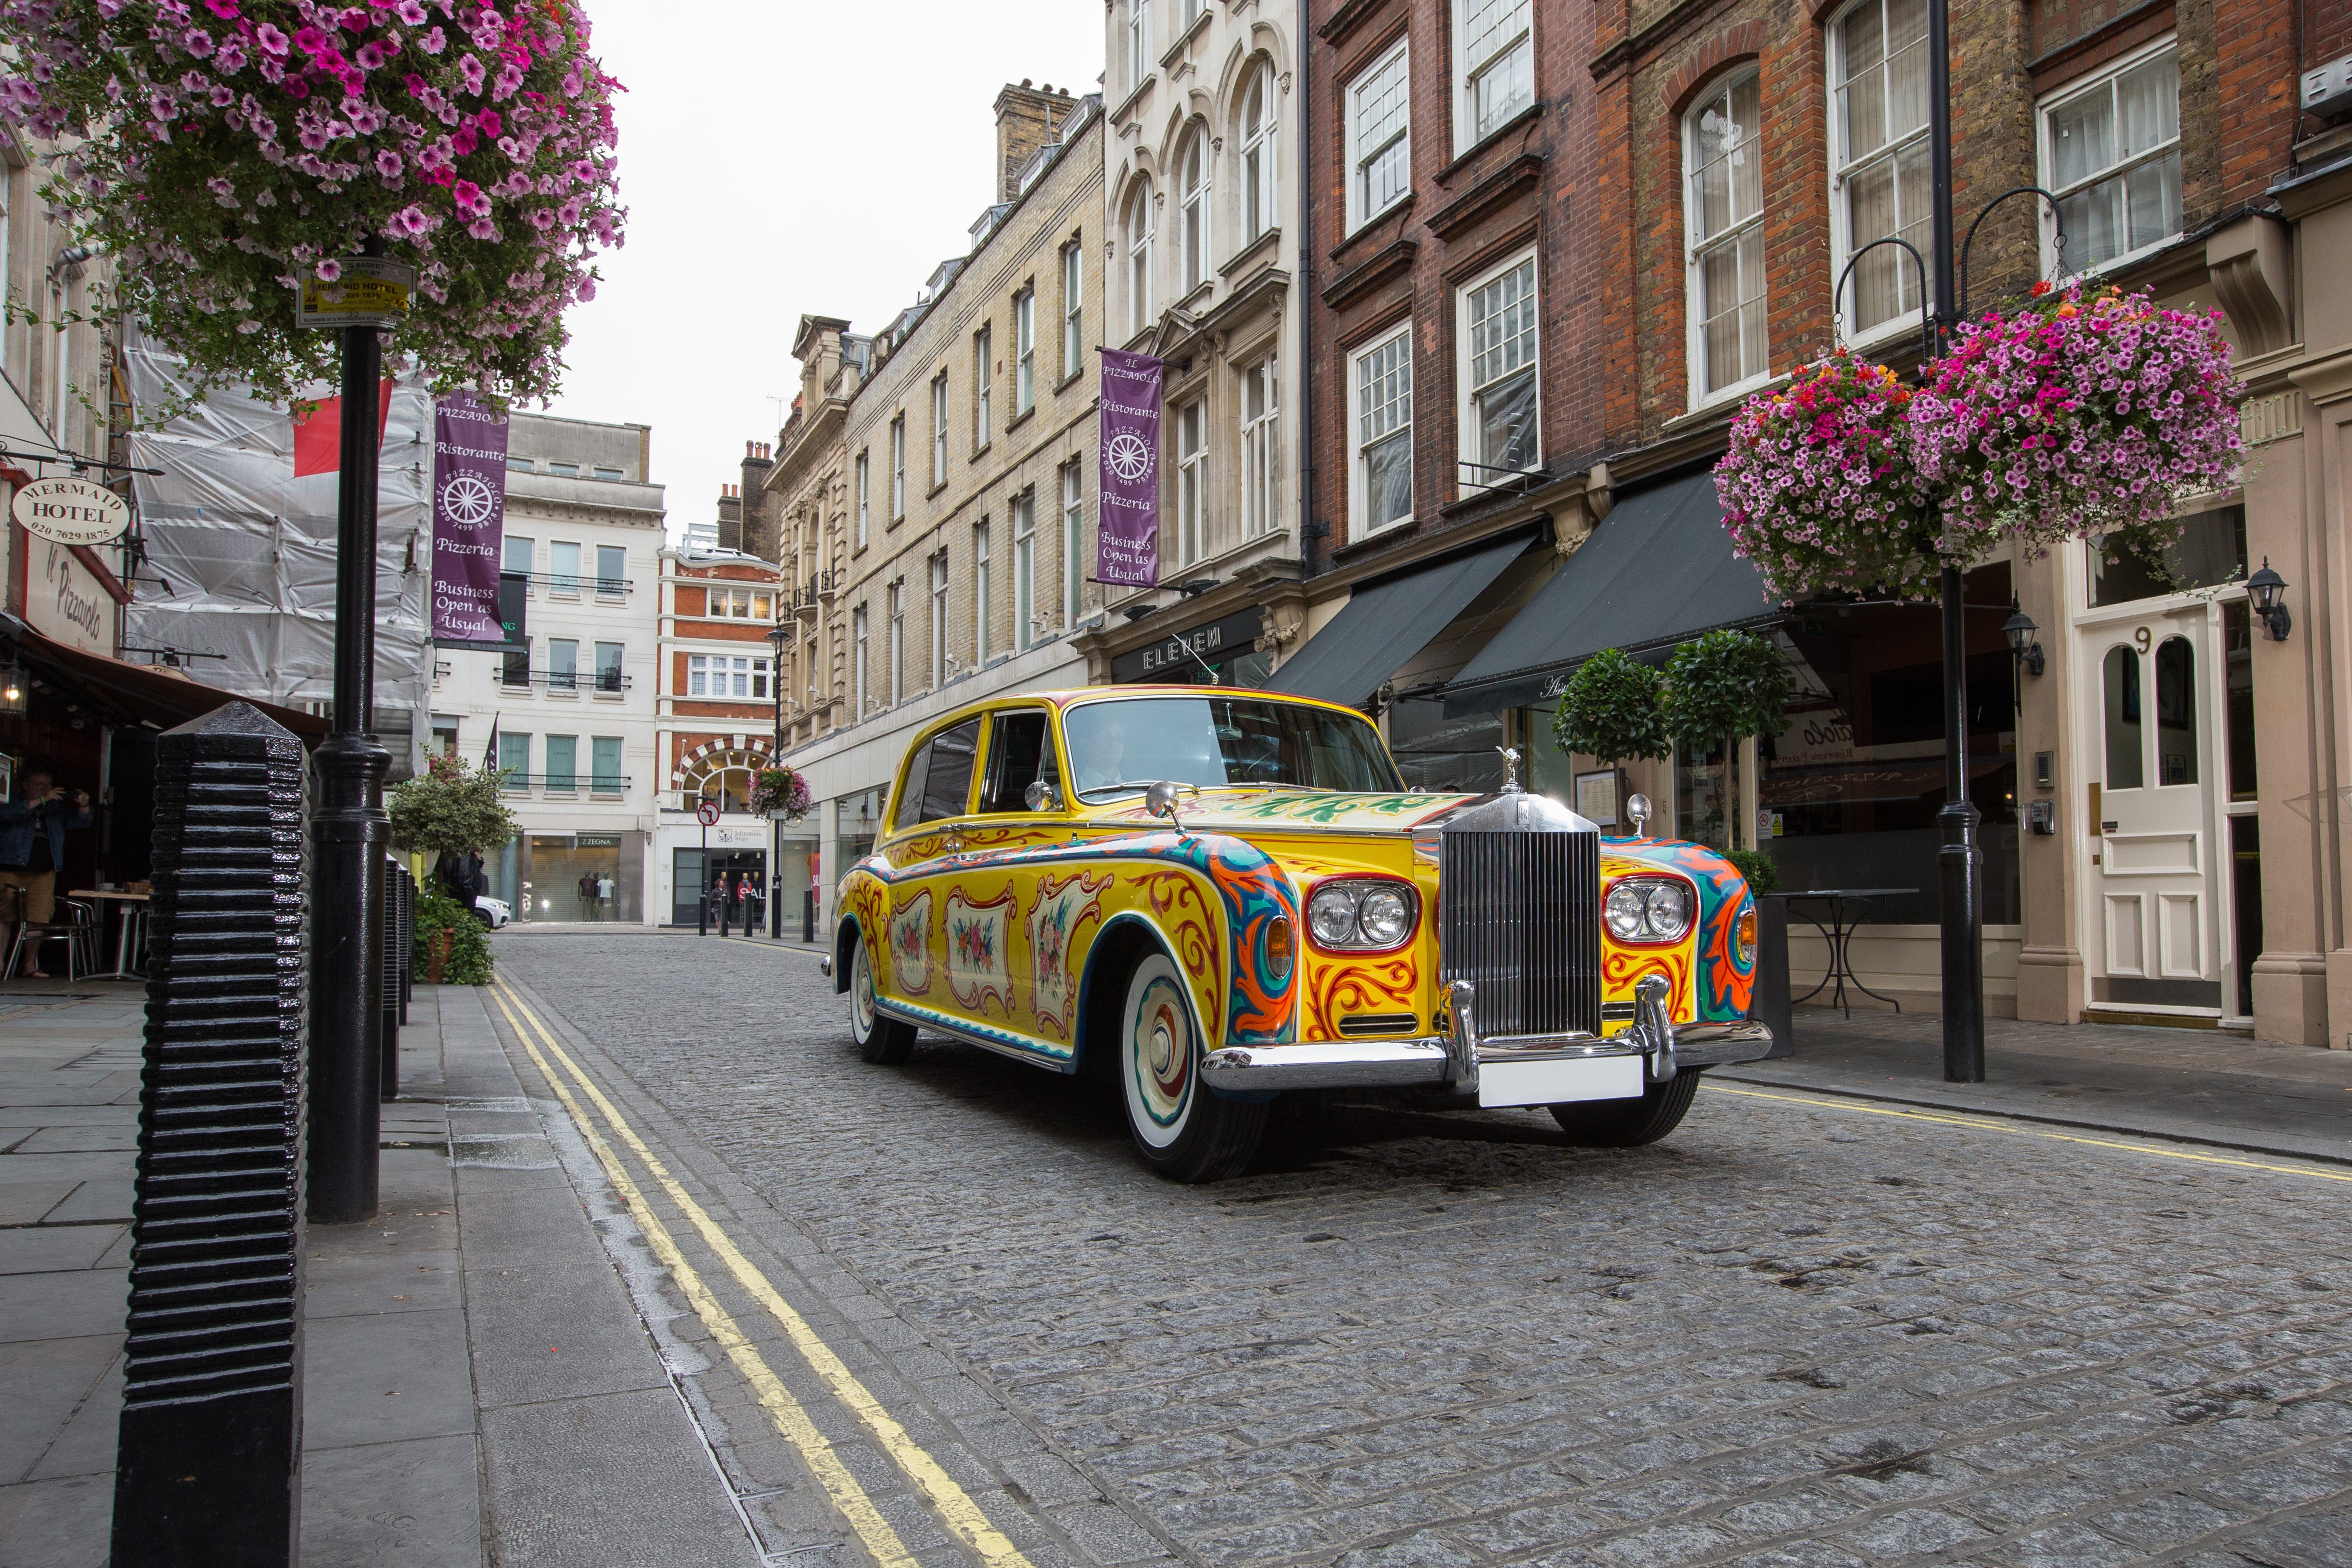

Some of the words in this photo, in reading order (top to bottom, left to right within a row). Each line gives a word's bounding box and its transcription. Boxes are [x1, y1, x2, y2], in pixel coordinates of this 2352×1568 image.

[363, 282, 398, 294] HOTEL
[1126, 359, 1137, 368] IL
[1103, 366, 1160, 383] PIZZAIOLO
[465, 398, 479, 408] IL
[1102, 399, 1158, 419] Ristorante
[437, 407, 508, 424] PIZZAIOO
[436, 442, 505, 461] Ristorante
[1102, 439, 1110, 451] IL
[1110, 426, 1156, 460] PIZZAIOLO
[1103, 460, 1114, 475] 020
[1116, 476, 1132, 486] 7499
[1136, 469, 1152, 485] 9878
[436, 483, 445, 496] IL
[445, 469, 502, 504] PIZZAIOLO
[22, 483, 122, 510] MERMAID
[1102, 492, 1151, 511] Pizzeria
[32, 502, 112, 523] HOTEL
[439, 506, 451, 522] 020
[453, 522, 473, 530] 7499
[478, 512, 497, 529] 9878
[31, 522, 51, 534] 020
[56, 530, 81, 540] 7629
[85, 529, 110, 540] 1875
[1101, 531, 1151, 550] Business
[437, 537, 494, 556] Pizzeria
[1102, 546, 1132, 565] Open
[1135, 555, 1148, 564] as
[1106, 566, 1145, 581] Usual
[435, 580, 494, 598] Business
[57, 561, 100, 641] Pizzaiolo
[437, 596, 474, 615] Open
[478, 604, 492, 613] as
[441, 616, 490, 631] Usual
[1143, 626, 1221, 670] ELEVEN
[2135, 626, 2151, 654] 9
[739, 888, 766, 899] SAL
